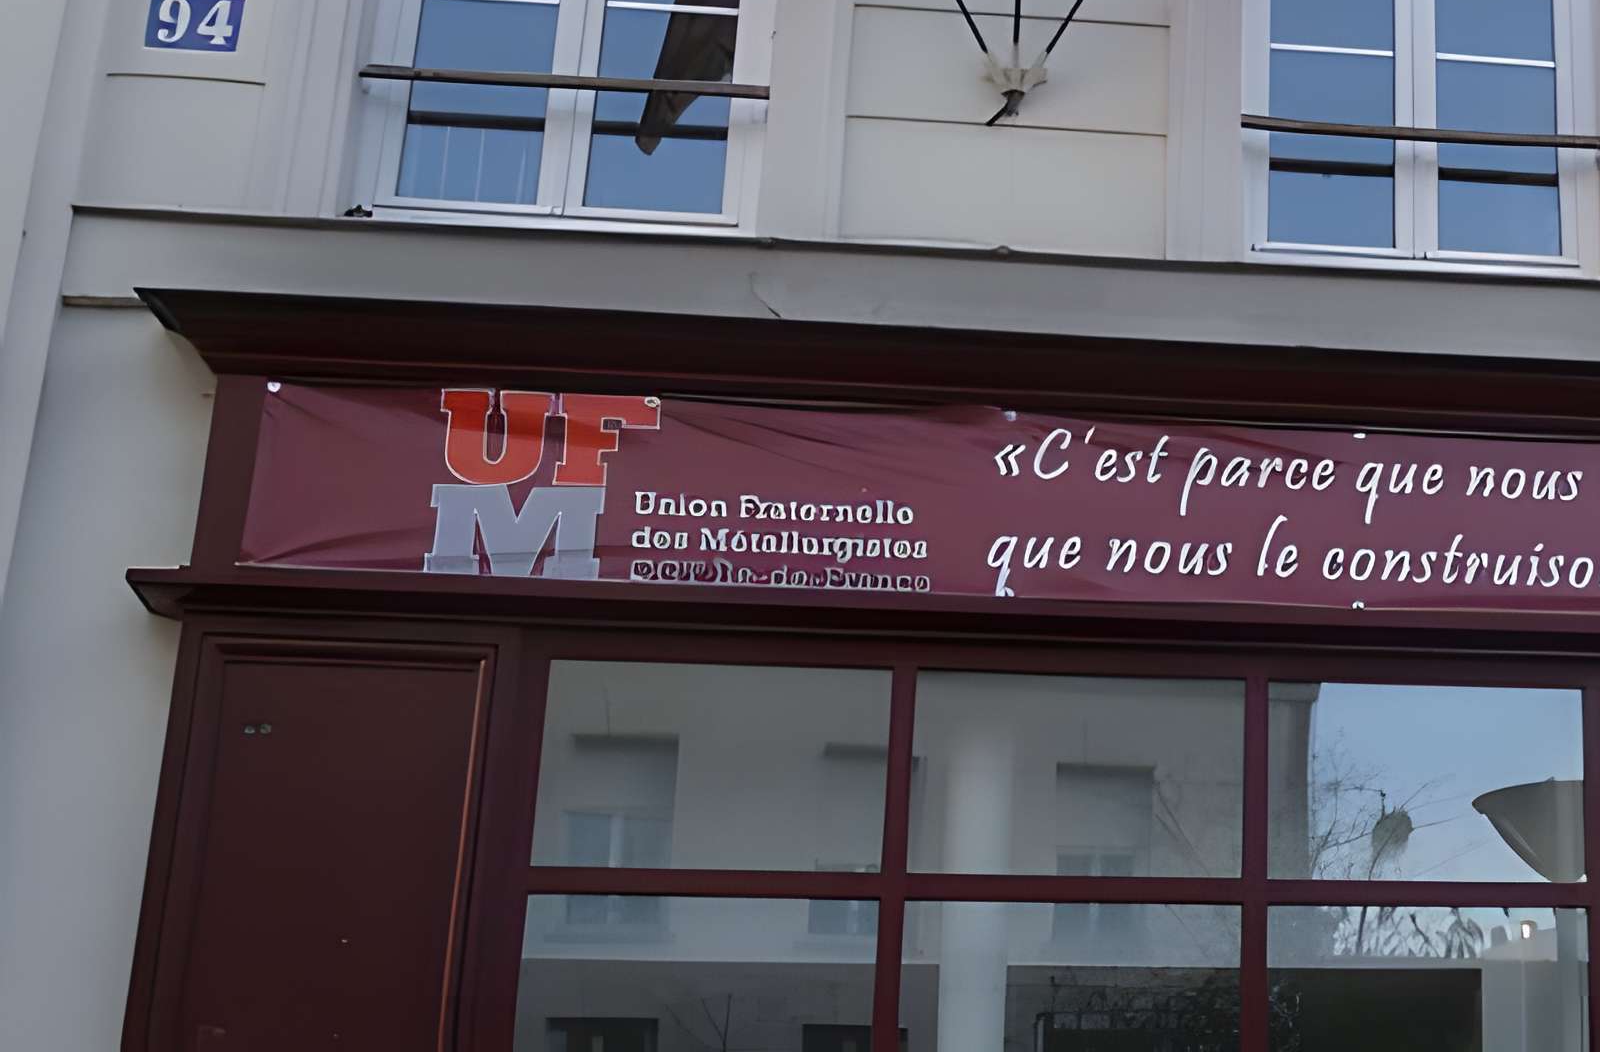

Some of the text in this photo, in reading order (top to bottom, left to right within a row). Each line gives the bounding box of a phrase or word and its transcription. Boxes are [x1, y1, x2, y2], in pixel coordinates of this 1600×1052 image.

[634, 491, 728, 518] Union
[1180, 447, 1336, 516] parce
[1354, 461, 1444, 525] que
[1465, 465, 1583, 501] nous
[986, 533, 1082, 597] que
[1105, 536, 1233, 577] nous
[1256, 514, 1299, 578] le
